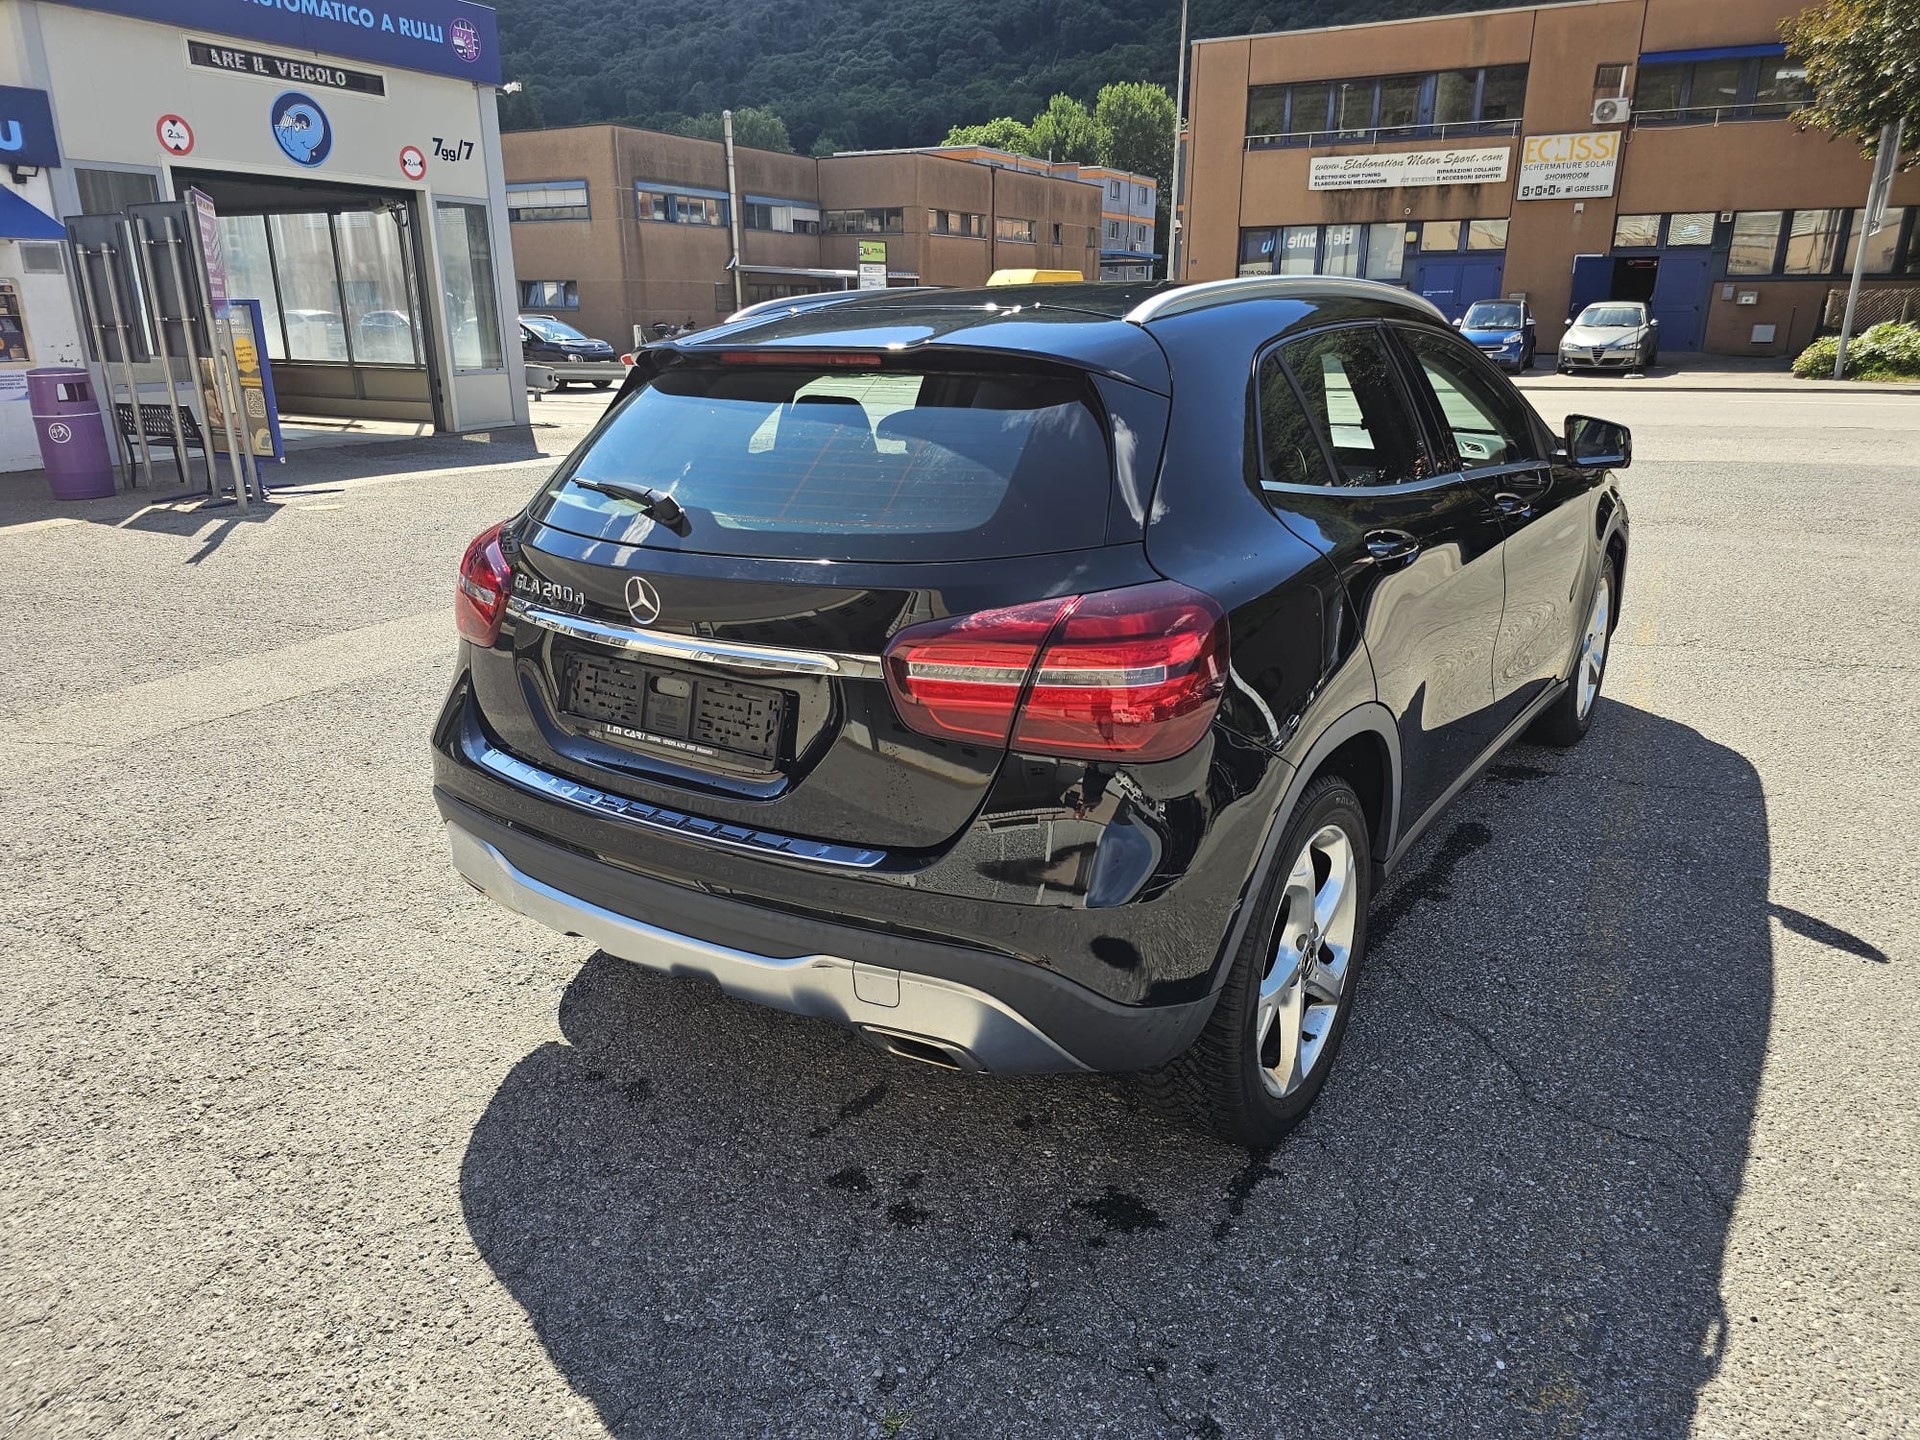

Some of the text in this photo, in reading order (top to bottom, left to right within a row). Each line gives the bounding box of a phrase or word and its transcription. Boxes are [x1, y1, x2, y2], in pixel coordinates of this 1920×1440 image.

[242, 0, 444, 43] TOMATICO A RULLI
[252, 56, 269, 74] IL
[275, 60, 347, 86] VEICOLO
[432, 137, 475, 162] 7gg/7
[1407, 154, 1441, 166] Motor
[1523, 160, 1615, 171] SCHERMATURE SOLARI
[1544, 172, 1590, 181] SHOWROOM
[1522, 184, 1609, 197] STOBAG GRIESSER
[514, 573, 585, 606] GLA 200 d
